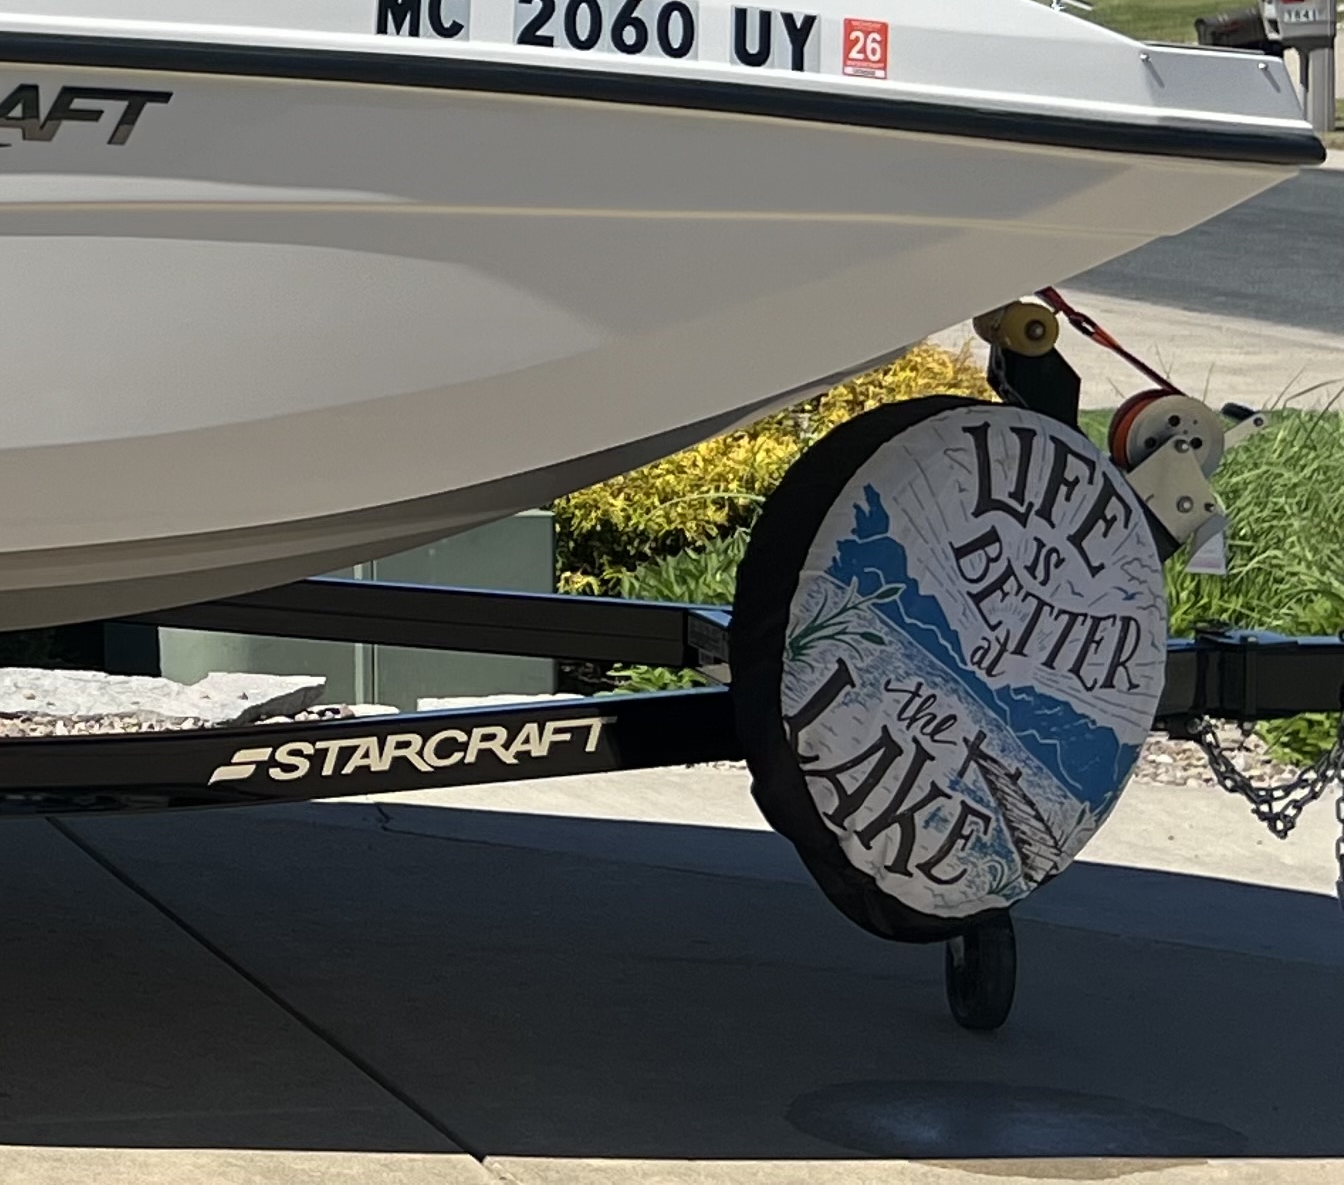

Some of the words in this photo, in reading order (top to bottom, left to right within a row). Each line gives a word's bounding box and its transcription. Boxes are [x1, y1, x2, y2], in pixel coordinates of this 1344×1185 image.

[732, 6, 819, 73] UY
[848, 30, 882, 63] 26
[962, 422, 1132, 577] LIFE
[1025, 536, 1064, 587] IS
[949, 524, 1141, 693] BETTER
[969, 628, 1013, 678] at
[883, 678, 960, 745] the
[268, 717, 604, 781] STARCRAFT
[782, 657, 994, 885] LAKE
